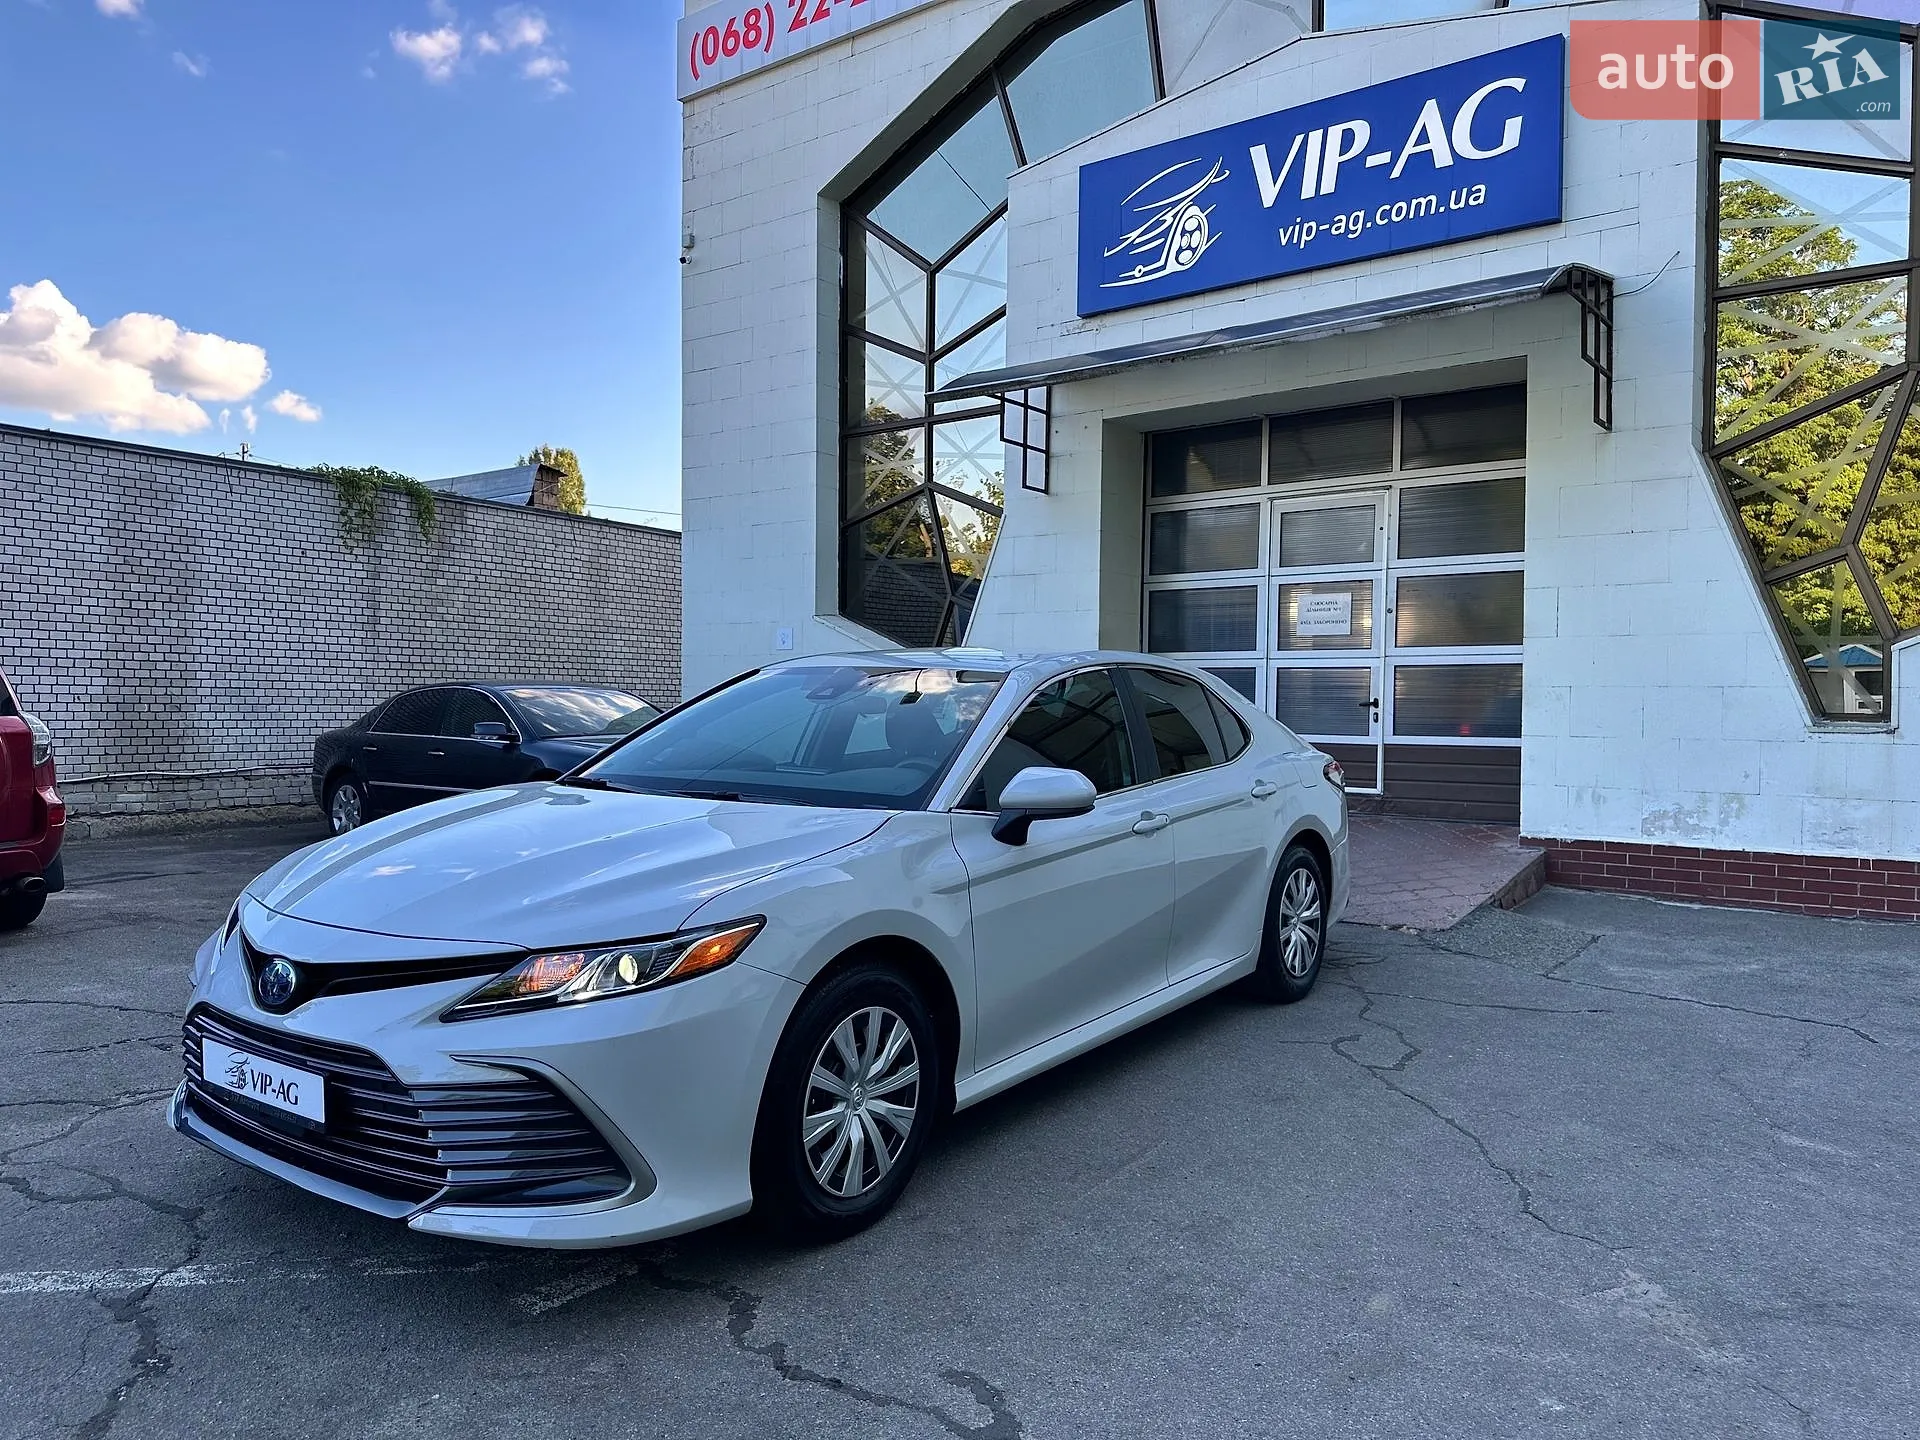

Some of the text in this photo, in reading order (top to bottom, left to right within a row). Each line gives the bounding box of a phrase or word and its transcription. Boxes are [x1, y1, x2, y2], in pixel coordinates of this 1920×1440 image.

[690, 0, 870, 81] (068) 22-
[1249, 77, 1527, 208] VIP-AG
[1278, 183, 1487, 249] vip-ag.com.ua
[250, 1068, 299, 1106] VIP-AG
